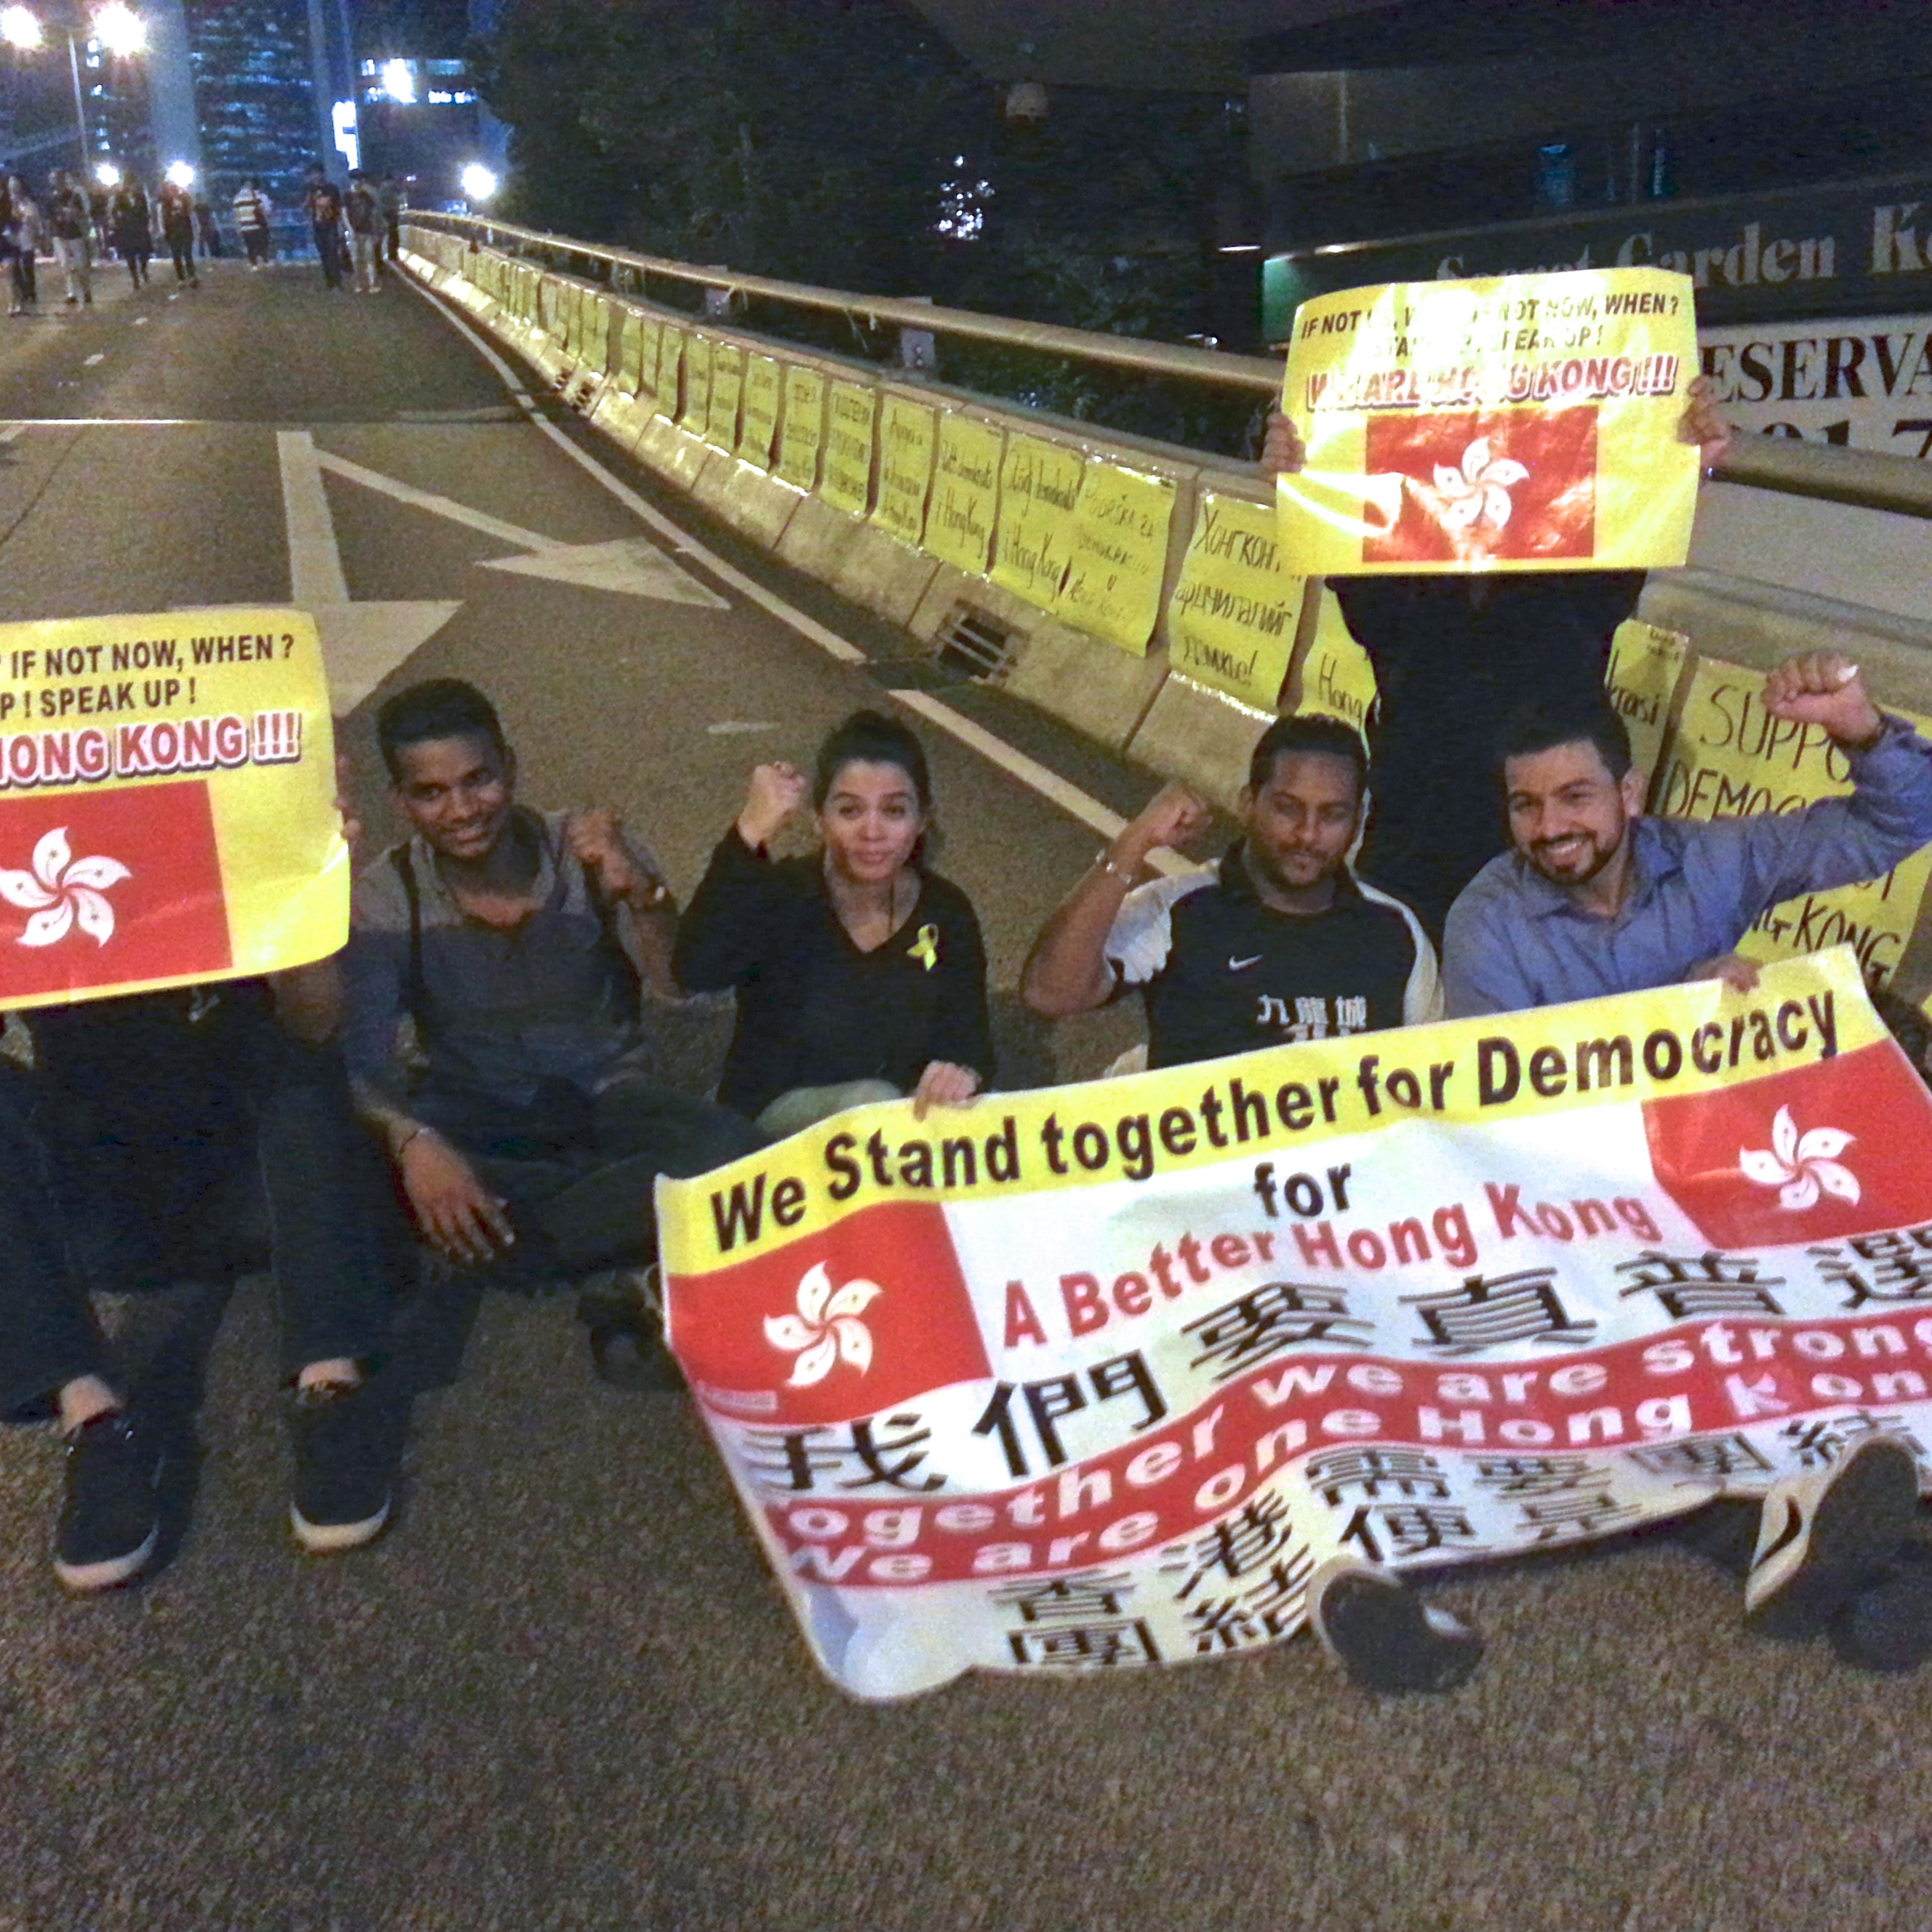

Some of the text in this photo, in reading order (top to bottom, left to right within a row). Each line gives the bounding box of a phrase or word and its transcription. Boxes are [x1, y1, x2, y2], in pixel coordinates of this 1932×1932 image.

[1873, 201, 1932, 272] K
[1302, 317, 1319, 340] IF
[1322, 309, 1362, 335] NOT
[1536, 356, 1632, 395] KONG
[1702, 332, 1932, 404] ESERVA
[12, 651, 36, 679] IF
[46, 645, 103, 678] NOT
[112, 638, 183, 673] NOW,
[0, 692, 16, 720] P
[40, 681, 136, 718] SPEAK
[1698, 683, 1853, 785] SUPPO
[0, 728, 106, 781] ONG
[120, 715, 243, 770] KONG
[1661, 759, 1808, 821] DEMO
[710, 989, 1837, 1253] We Stand together for Democracy
[1254, 1161, 1352, 1218] for
[1003, 1181, 1662, 1352] A Better Hong Kong
[772, 1405, 1225, 1543] ogether
[1252, 1363, 1403, 1408] we
[1436, 1361, 1607, 1403] are
[973, 1510, 1159, 1574] are
[1194, 1409, 1382, 1510] one
[1418, 1393, 1692, 1445] Hong
[1723, 1369, 1929, 1417] kon
